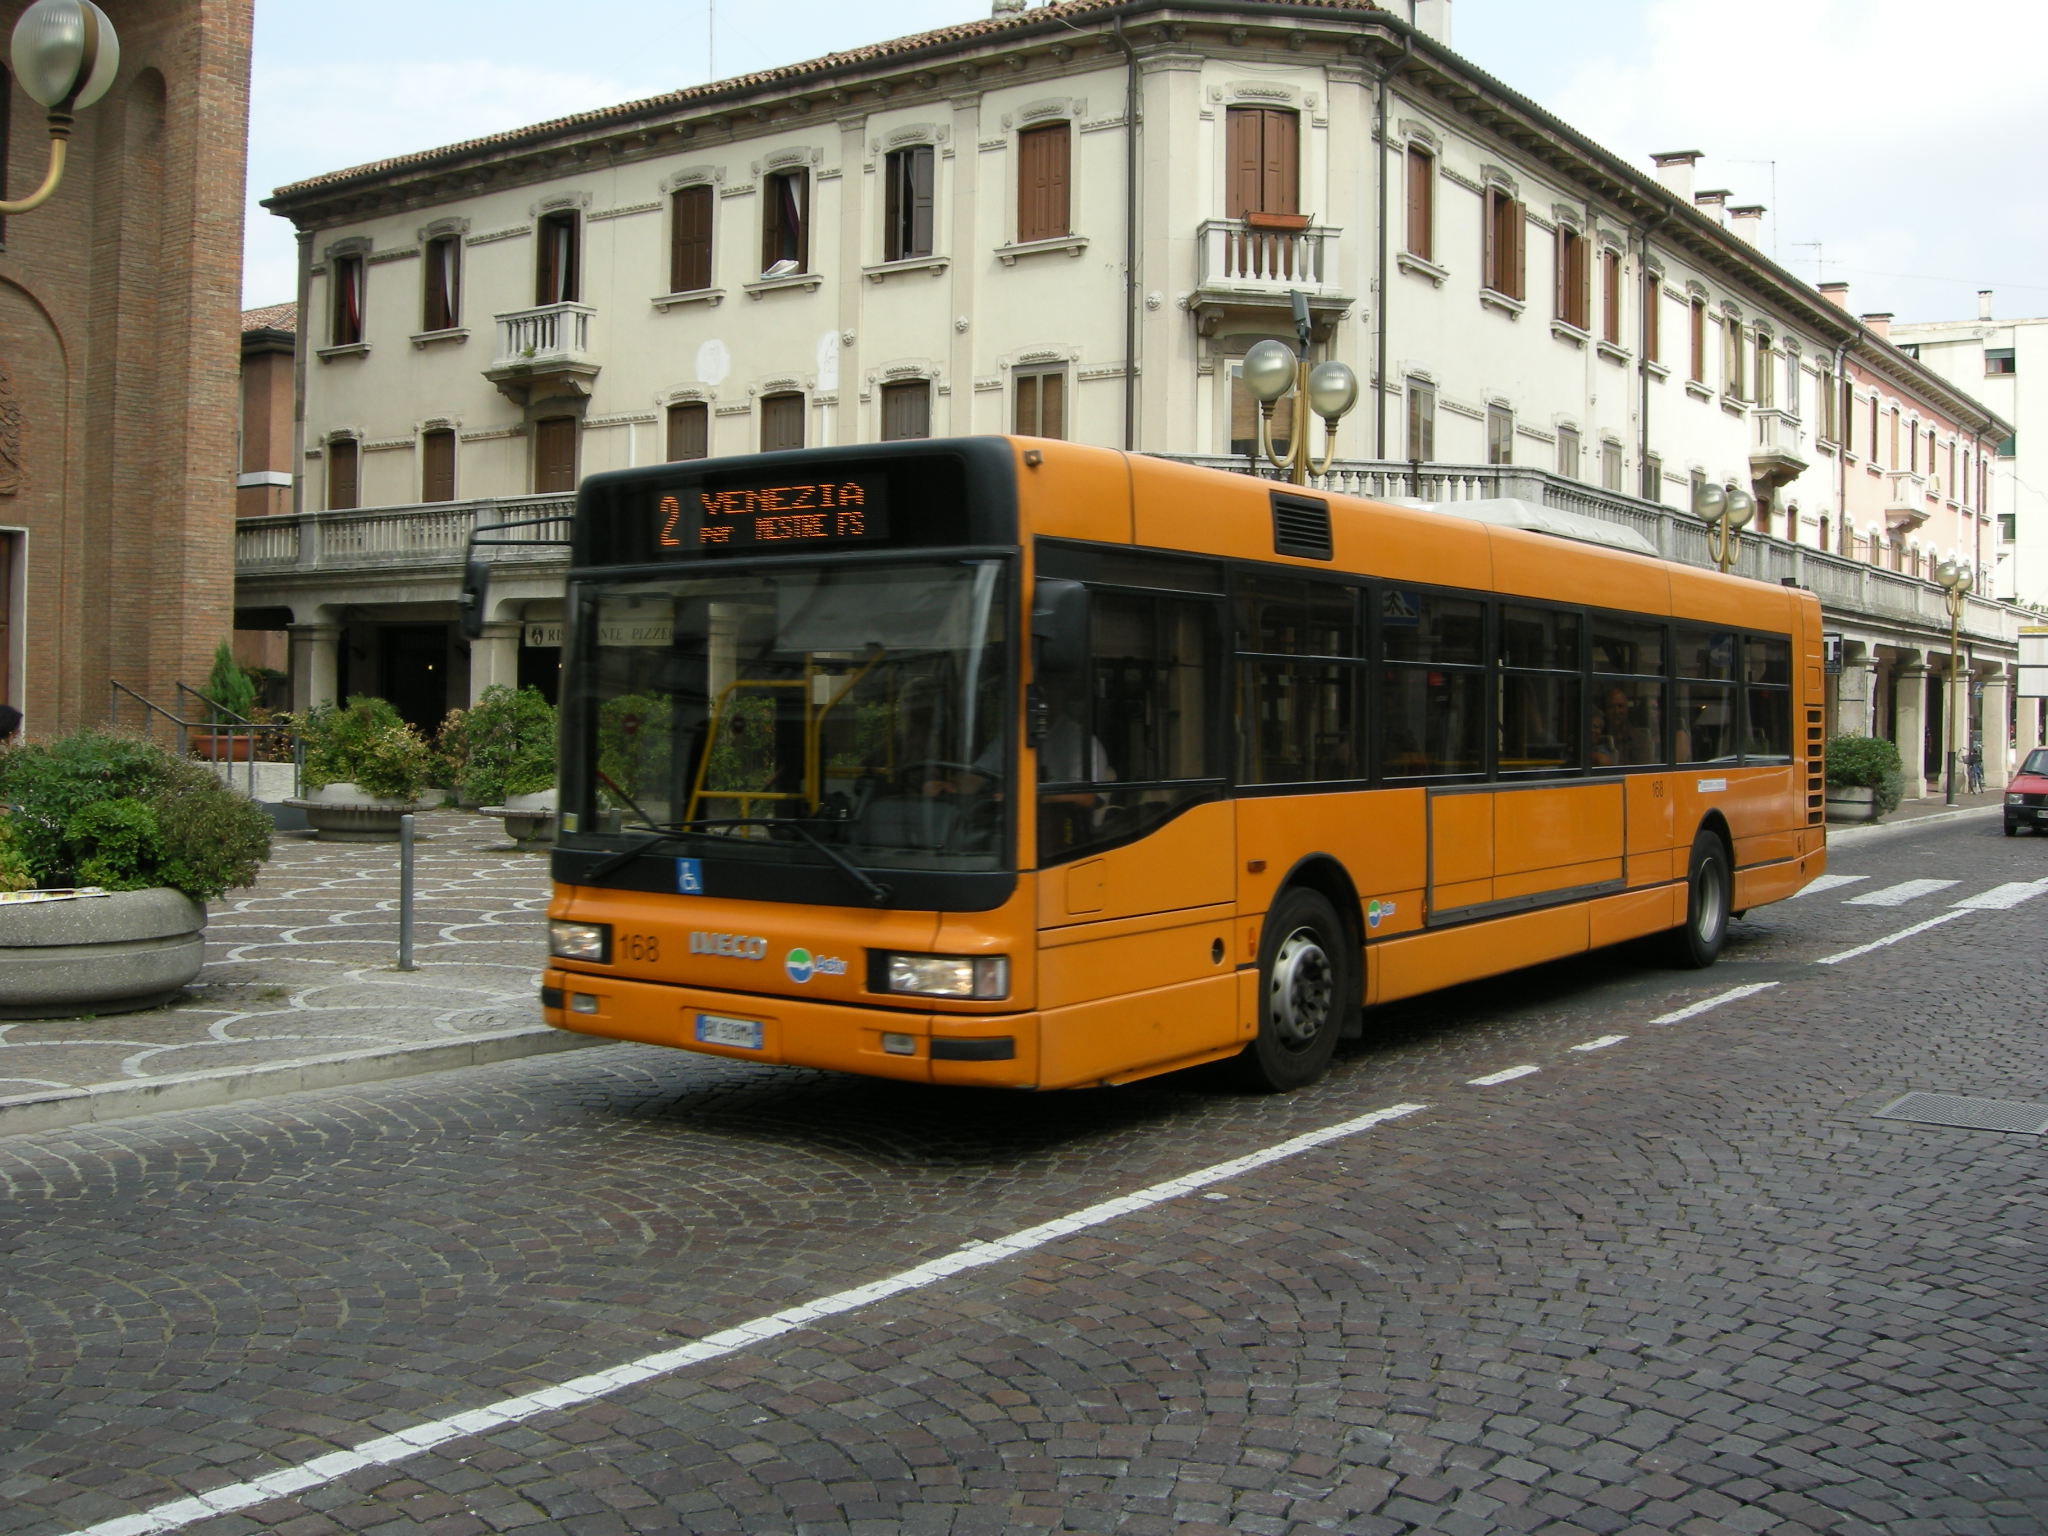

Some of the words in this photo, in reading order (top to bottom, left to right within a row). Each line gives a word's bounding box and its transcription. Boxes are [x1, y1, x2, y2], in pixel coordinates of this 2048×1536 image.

[660, 496, 680, 546] 2
[701, 482, 864, 515] VENEZIA
[755, 514, 829, 540] MESTRE
[837, 511, 864, 536] FS
[1652, 780, 1664, 797] 168
[619, 934, 660, 963] 168
[689, 931, 767, 960] IVECO
